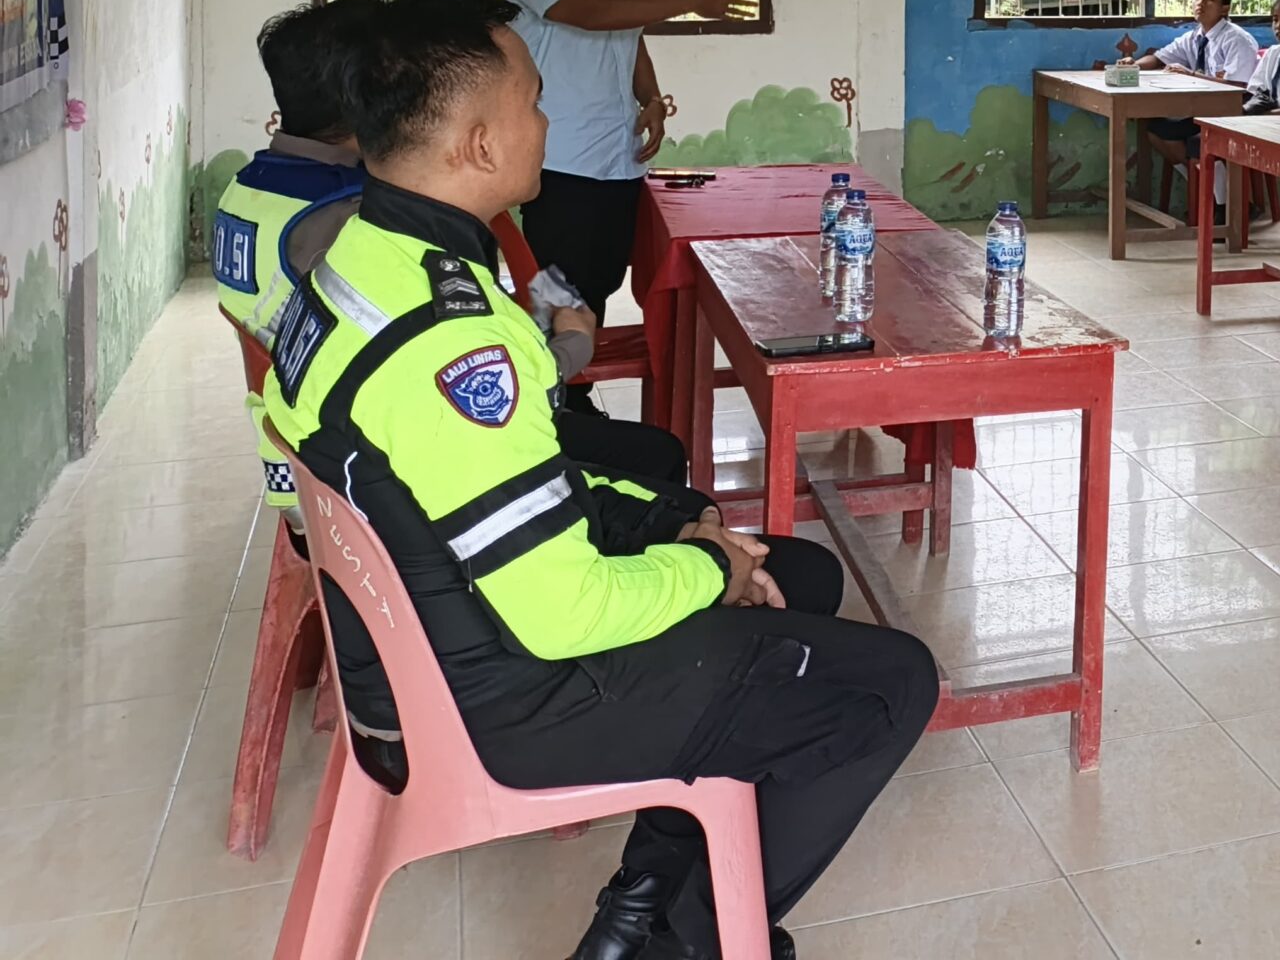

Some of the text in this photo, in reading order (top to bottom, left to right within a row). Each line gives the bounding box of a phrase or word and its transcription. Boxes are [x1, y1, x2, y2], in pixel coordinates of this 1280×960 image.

[849, 233, 873, 244] AQUA
[1000, 247, 1024, 258] AQUA
[442, 349, 502, 383] LALU LINTAS
